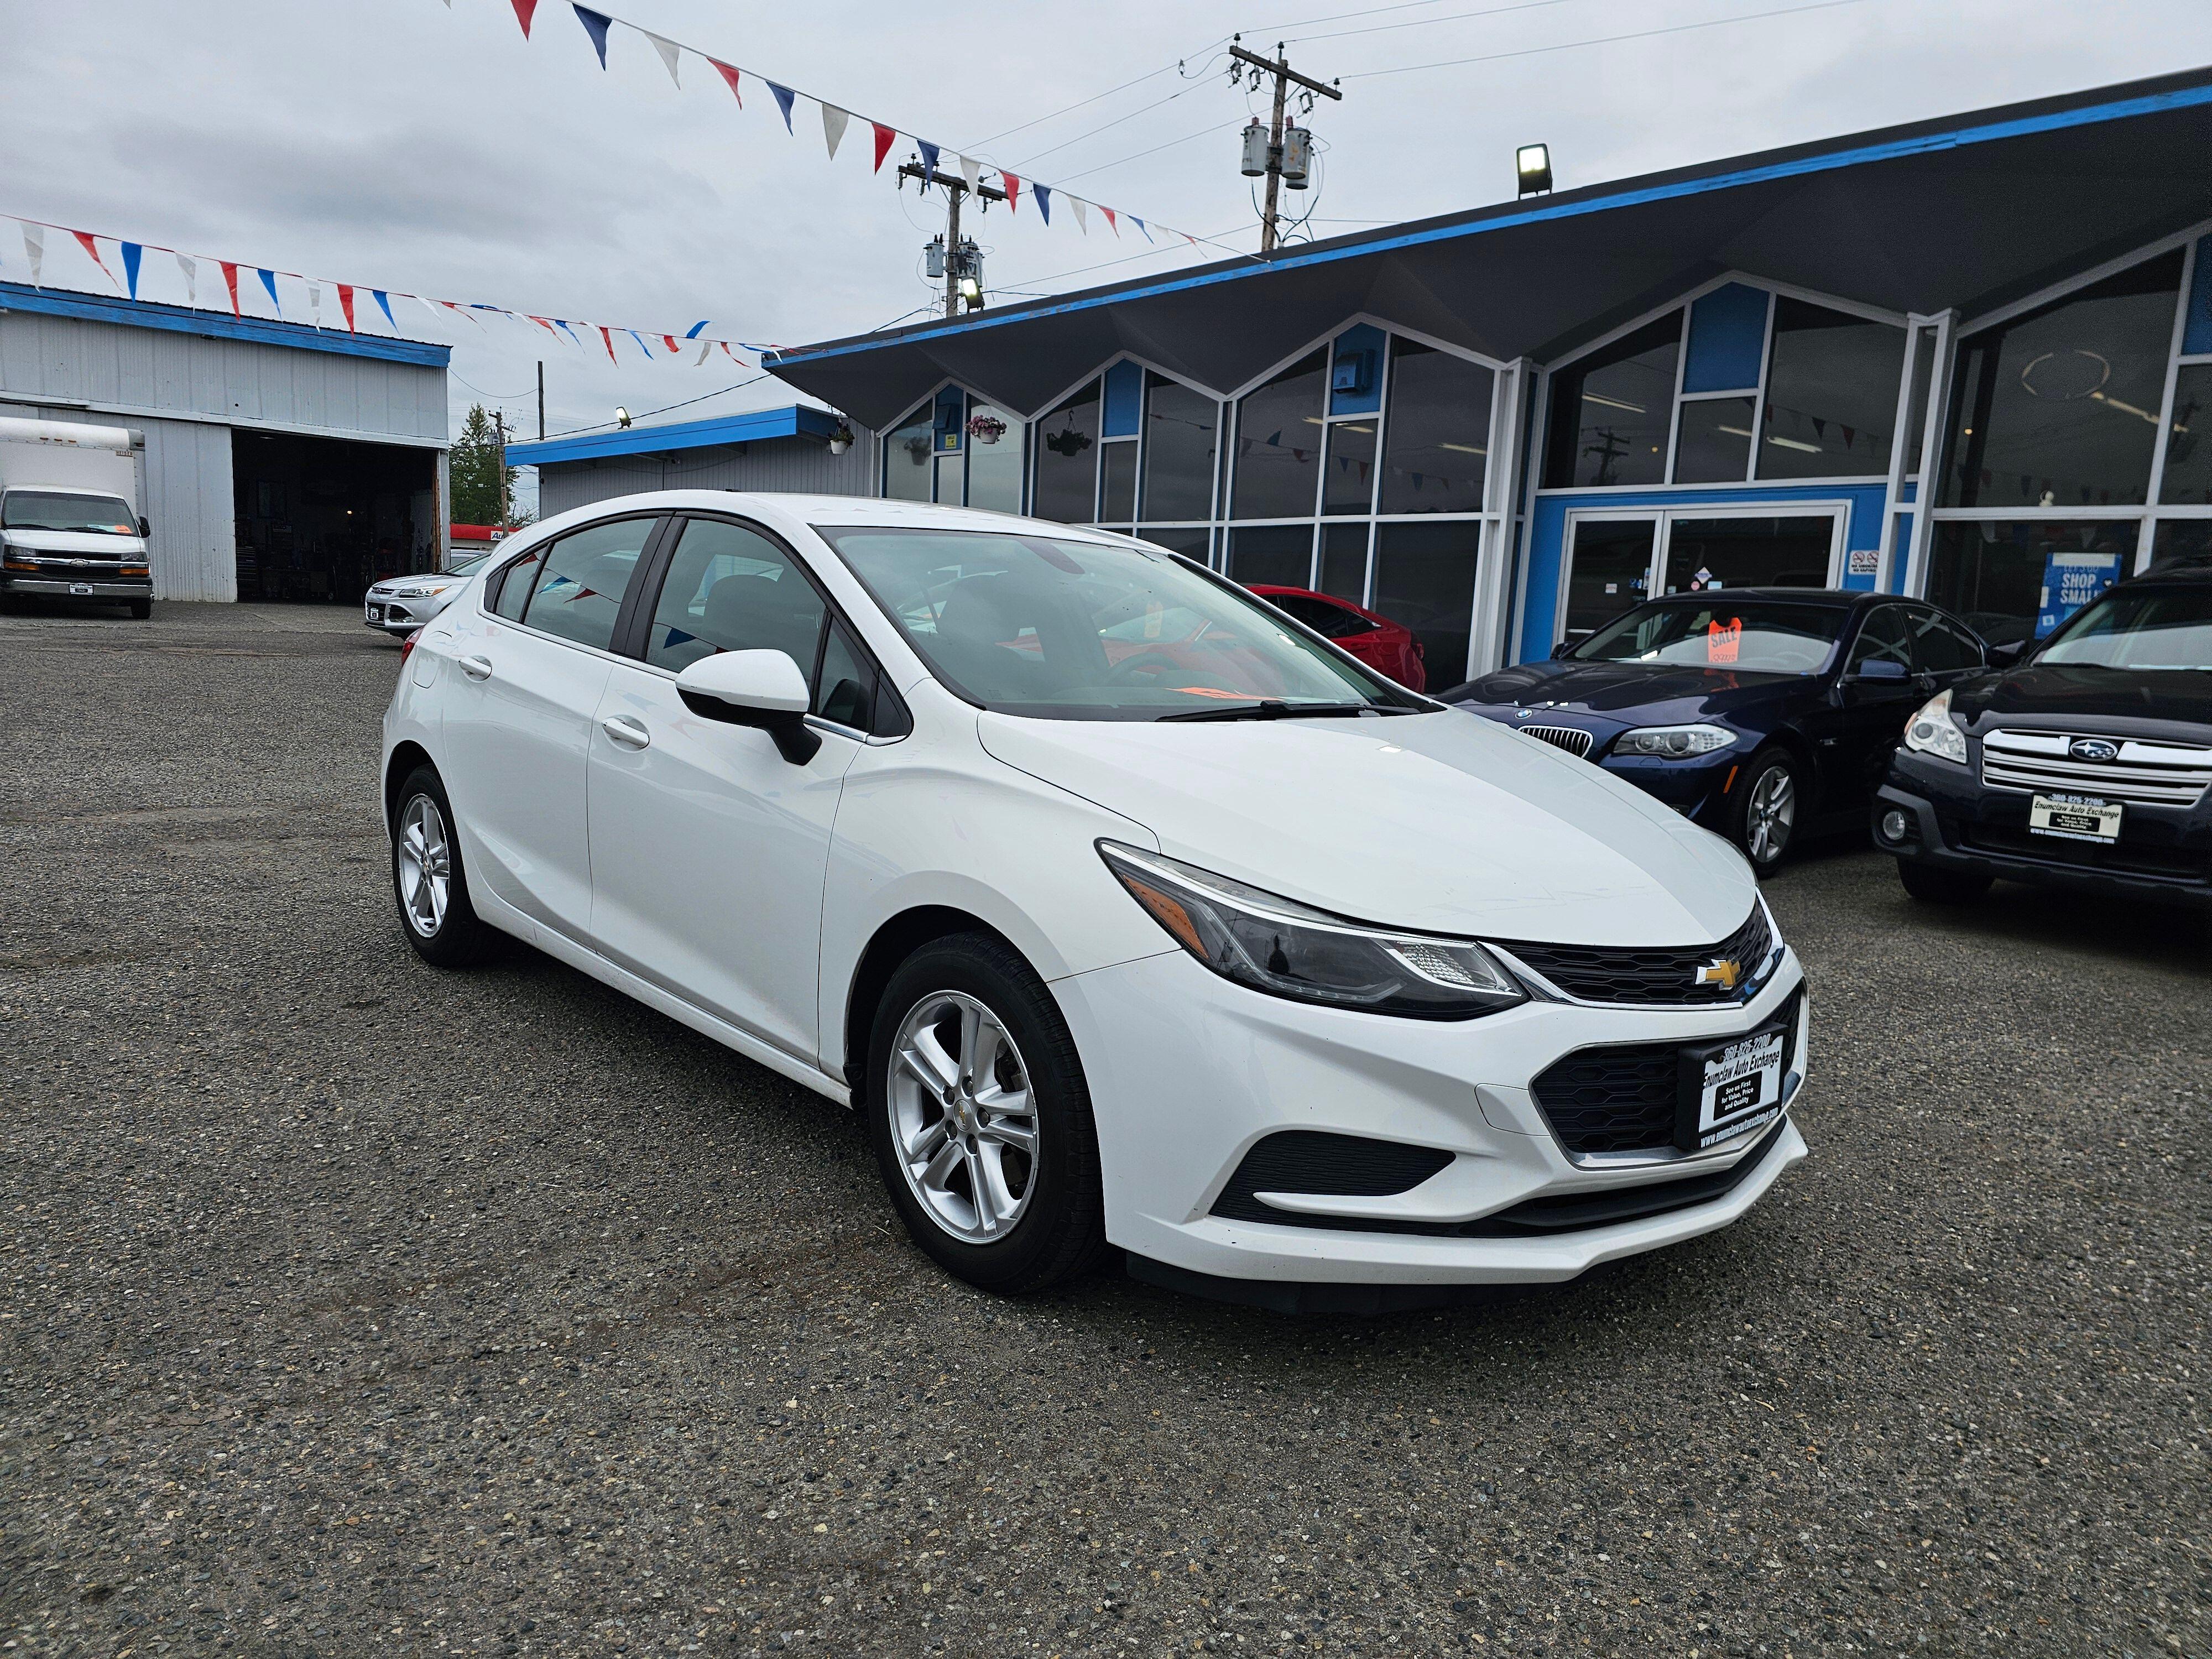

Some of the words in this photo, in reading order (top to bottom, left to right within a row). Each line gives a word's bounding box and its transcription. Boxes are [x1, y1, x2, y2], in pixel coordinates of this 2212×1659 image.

[2062, 573, 2096, 588] SHOP
[1711, 626, 1737, 648] SALE
[2034, 801, 2068, 811] Enumclaw
[2069, 805, 2085, 813] Auto
[2086, 807, 2119, 820] Exchange
[1724, 1033, 1771, 1061] 360-825-2200
[1733, 1059, 1749, 1077] Auto
[1749, 1050, 1780, 1072] Exchange
[1741, 1080, 1751, 1088] First
[1743, 1087, 1754, 1095] Price
[1734, 1097, 1749, 1107] Quality
